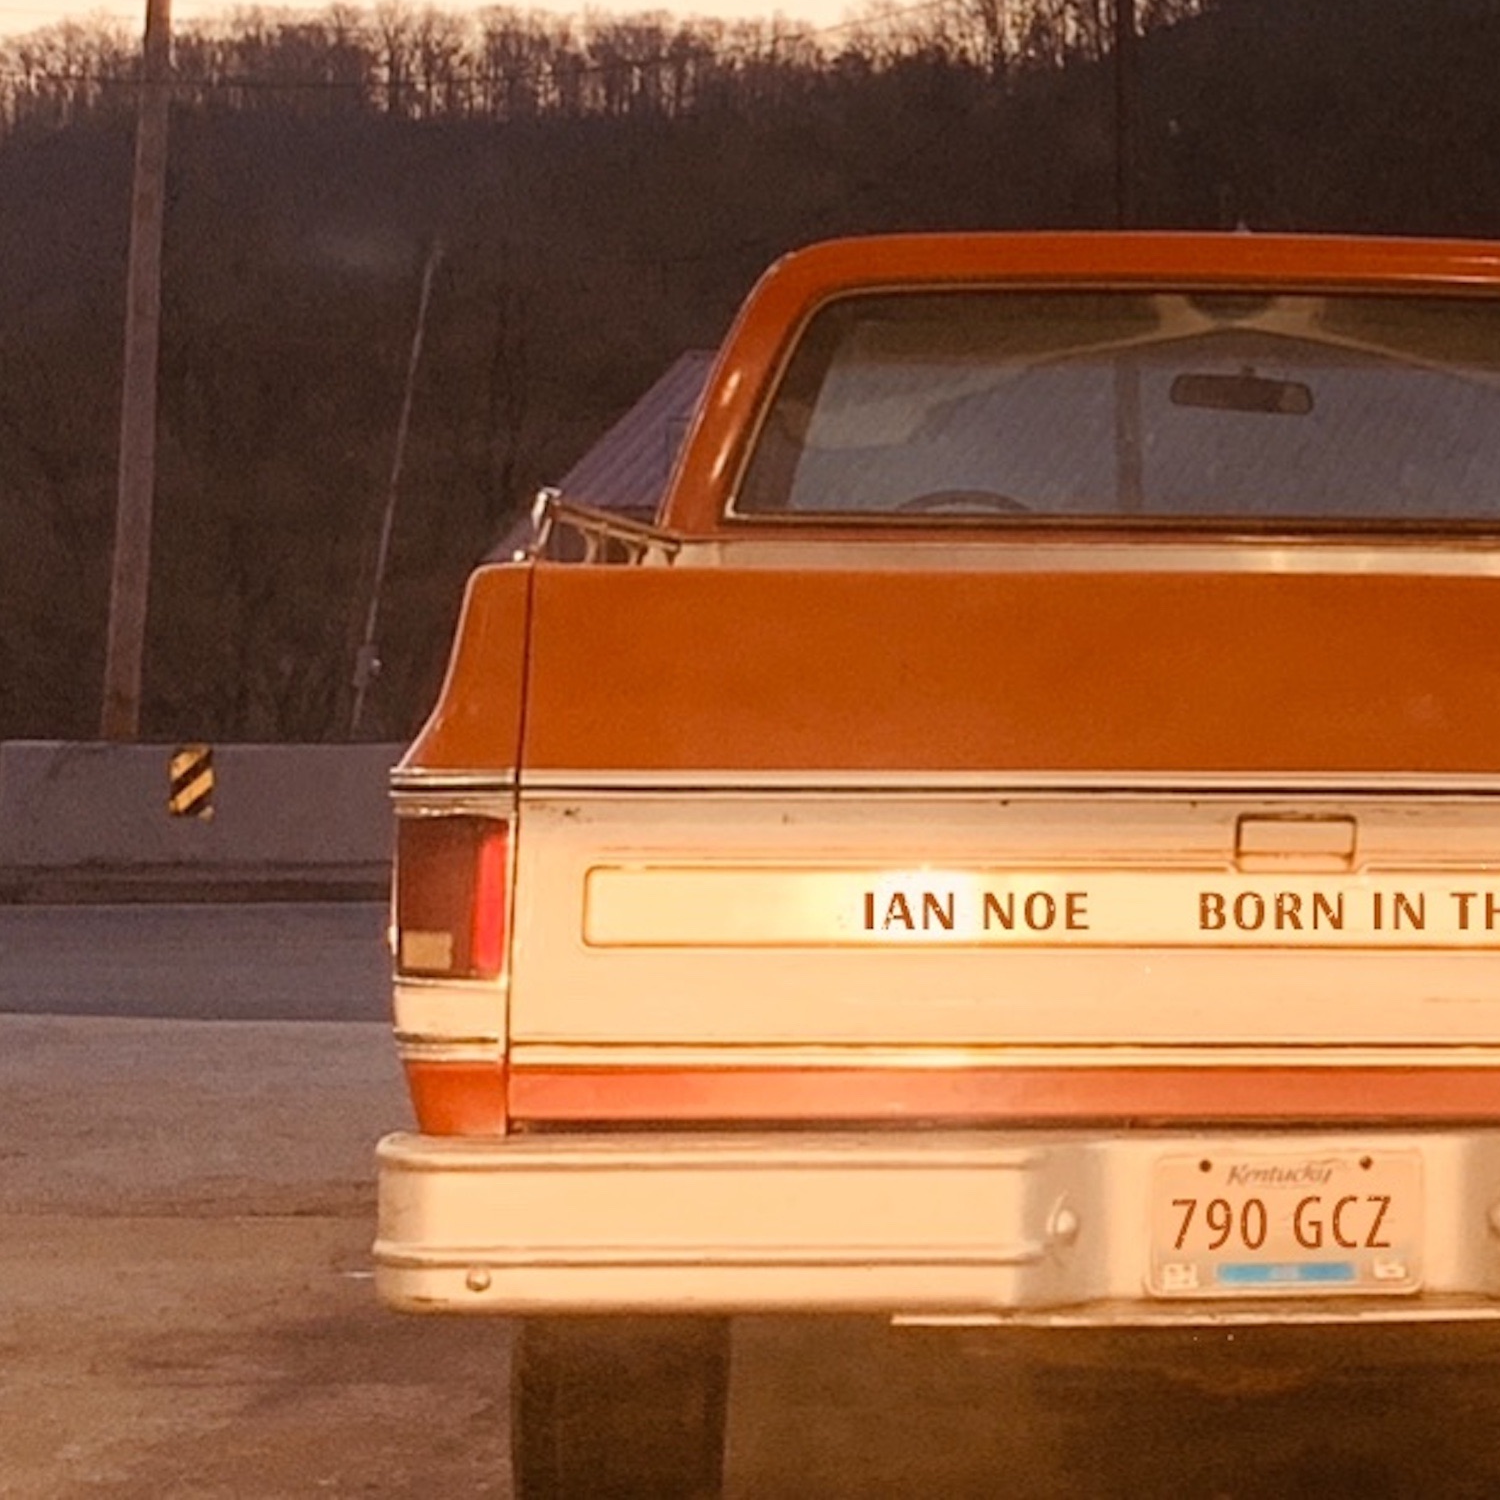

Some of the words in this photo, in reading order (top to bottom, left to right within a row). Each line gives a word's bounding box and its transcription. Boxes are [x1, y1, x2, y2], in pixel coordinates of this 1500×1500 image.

[864, 891, 954, 931] IAN
[984, 891, 1089, 931] NOE
[1200, 891, 1343, 931] BORN
[1373, 891, 1425, 931] IN
[1226, 1162, 1333, 1186] Kentucky
[1172, 1197, 1267, 1251] 790
[1293, 1195, 1391, 1250] GCZ
